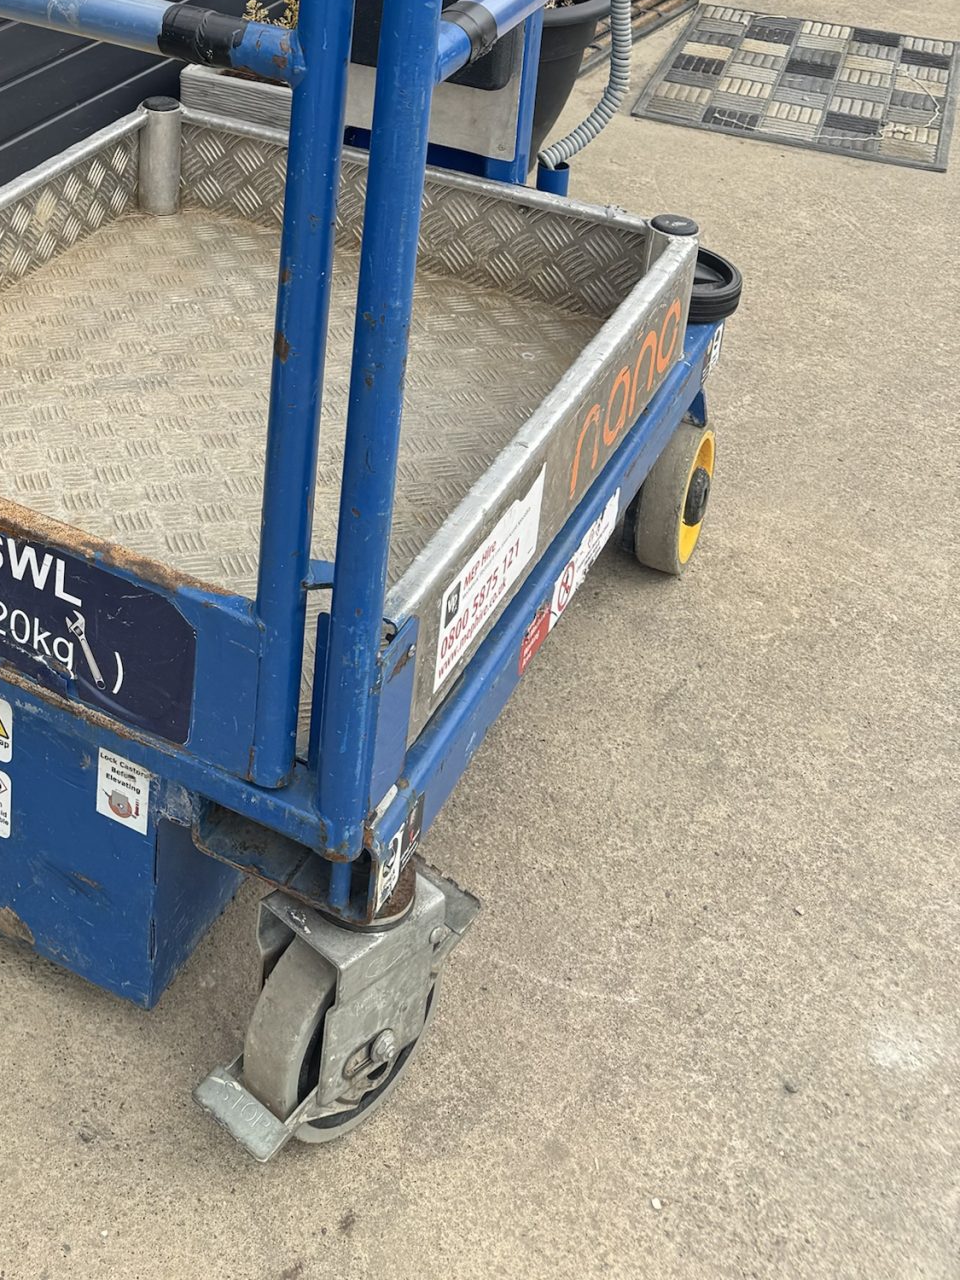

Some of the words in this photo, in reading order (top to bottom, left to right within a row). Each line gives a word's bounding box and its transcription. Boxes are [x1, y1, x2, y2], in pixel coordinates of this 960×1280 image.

[569, 296, 681, 500] nano
[463, 560, 480, 590] MEP
[481, 540, 497, 566] Hire
[441, 609, 469, 659] 0800
[471, 565, 500, 618] 5875
[502, 538, 520, 574] 121
[100, 752, 118, 766] Lock
[105, 773, 141, 795] Elevating
[217, 1080, 272, 1128] STOP
